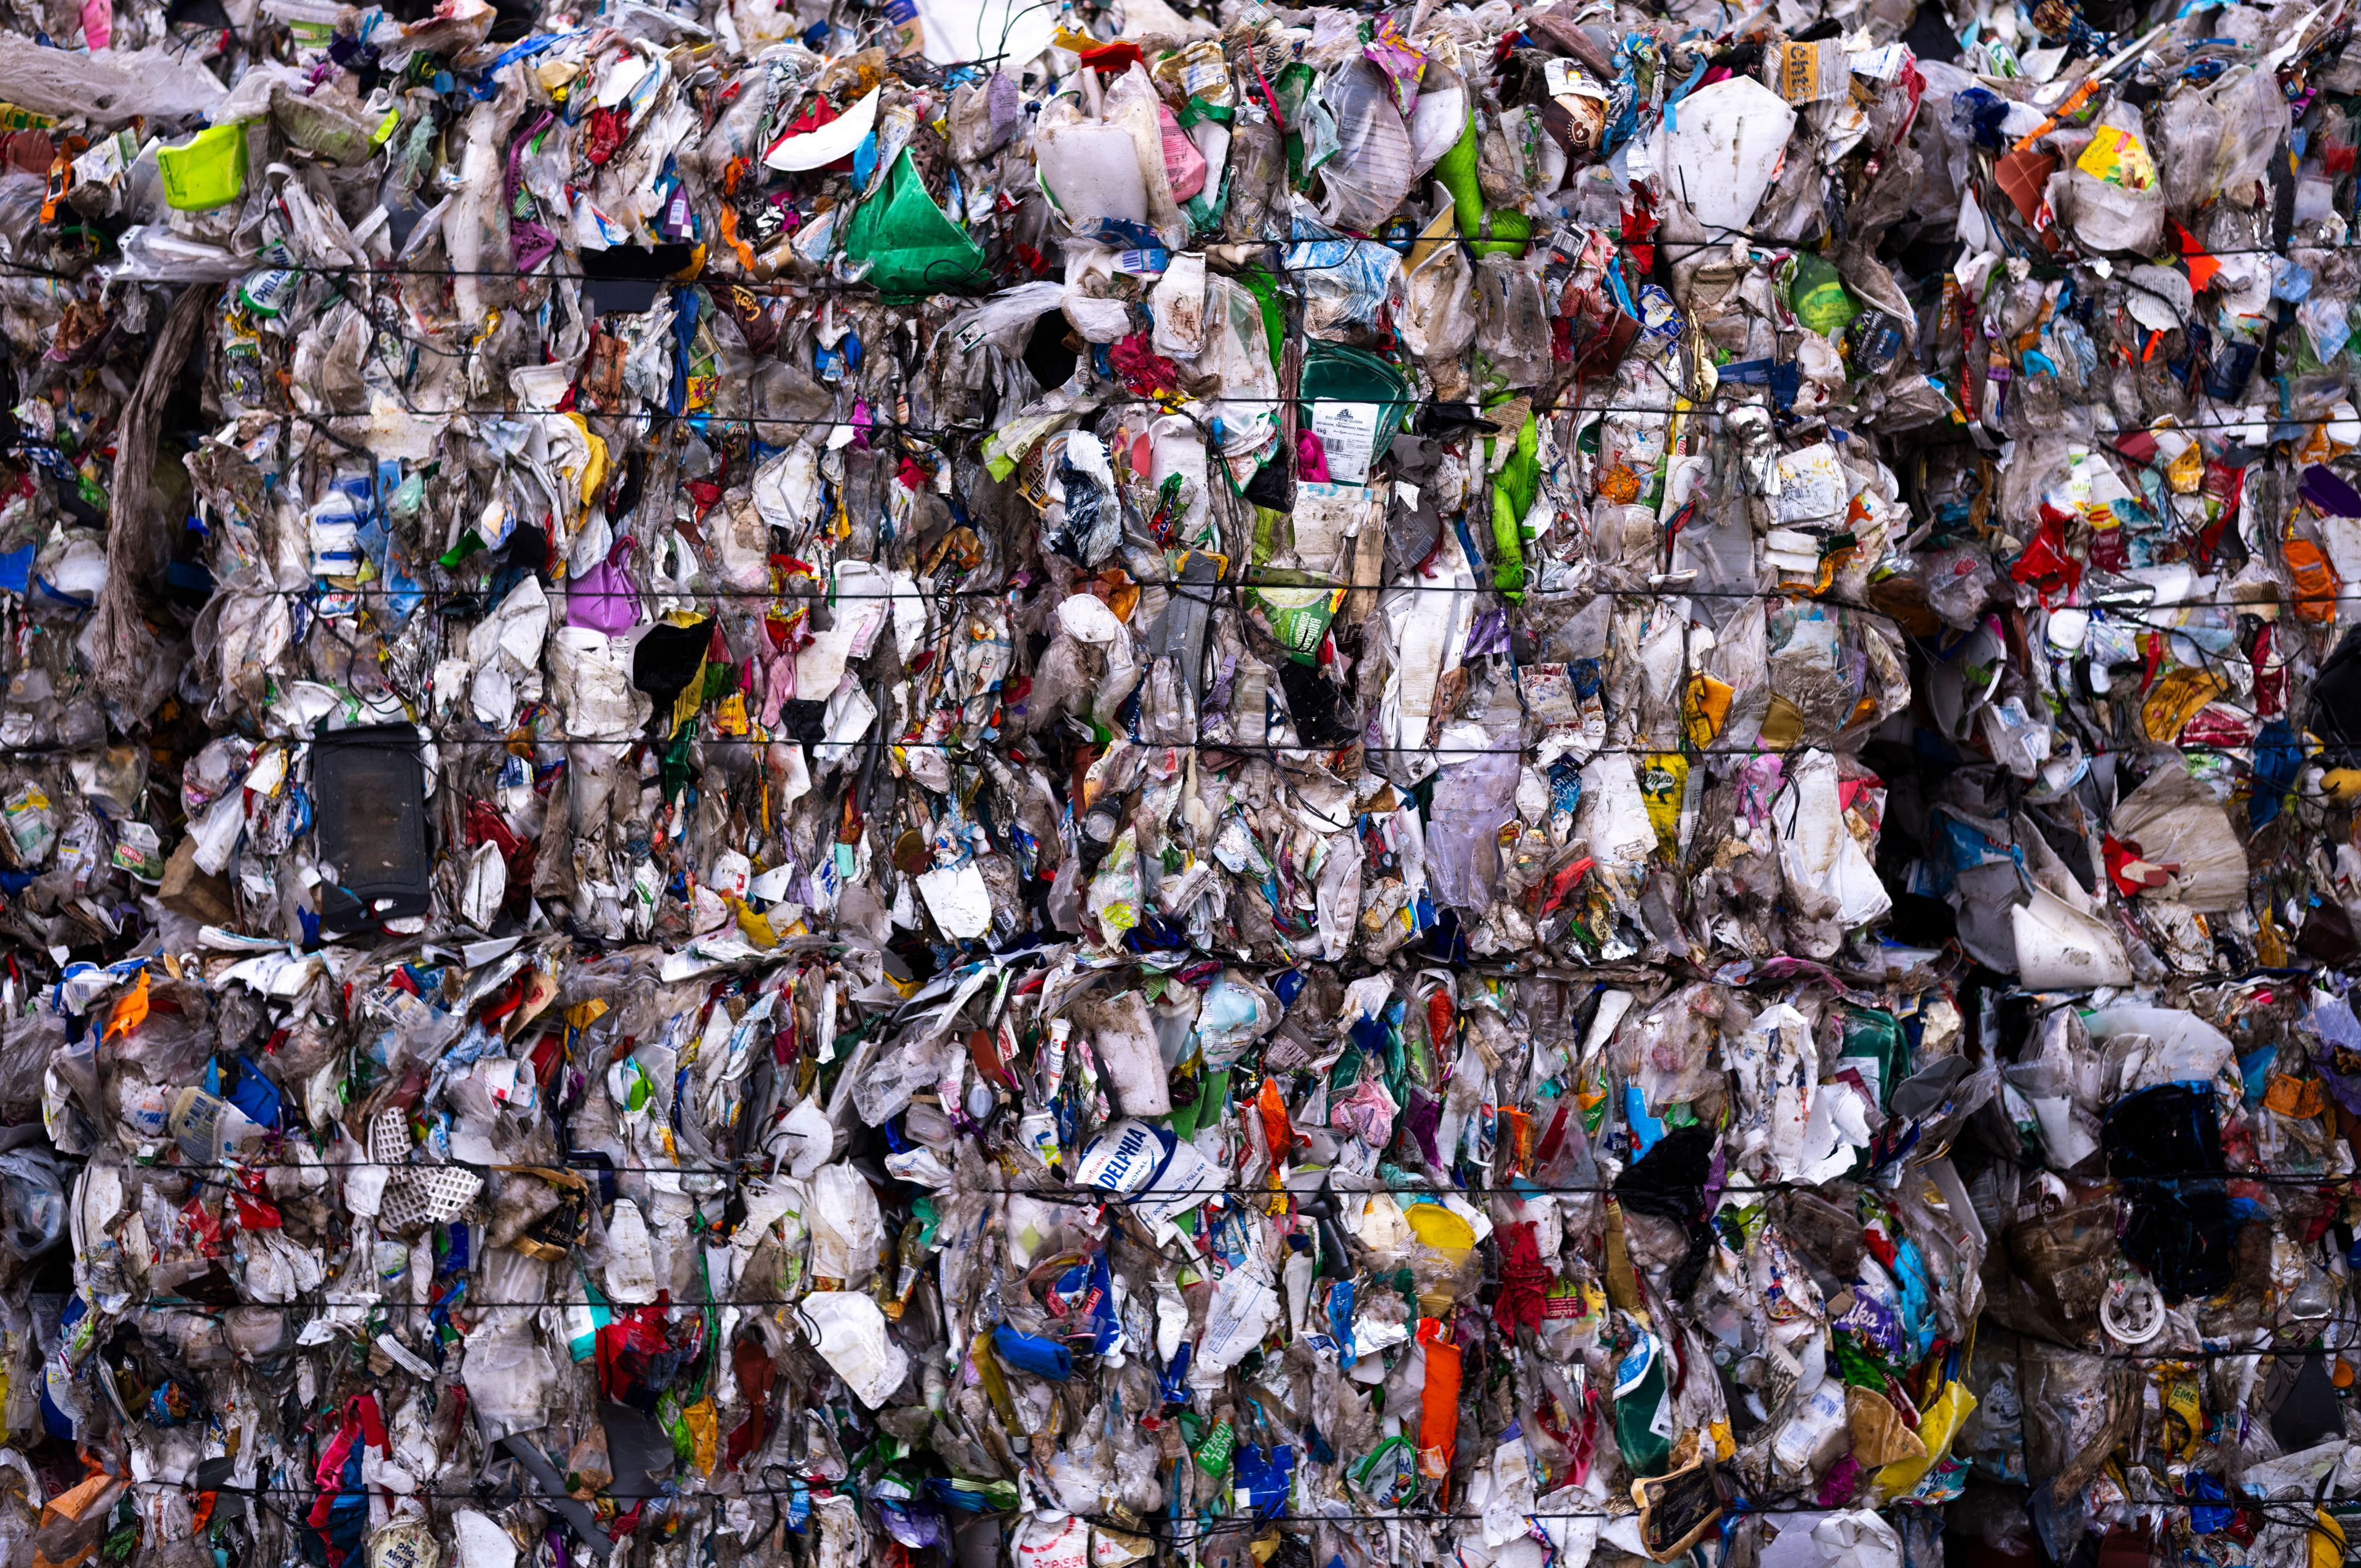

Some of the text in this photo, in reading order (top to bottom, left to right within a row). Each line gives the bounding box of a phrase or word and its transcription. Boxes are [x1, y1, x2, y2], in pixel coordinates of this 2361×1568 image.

[1326, 415, 1363, 424] BIO-SPEISEQUARK
[1026, 463, 1045, 486] MAS
[1153, 1182, 1185, 1217] DOUBLE-CRME
[1187, 1171, 1198, 1184] FULL
[1196, 1162, 1206, 1173] FAT
[1090, 1291, 1101, 1303] Land
